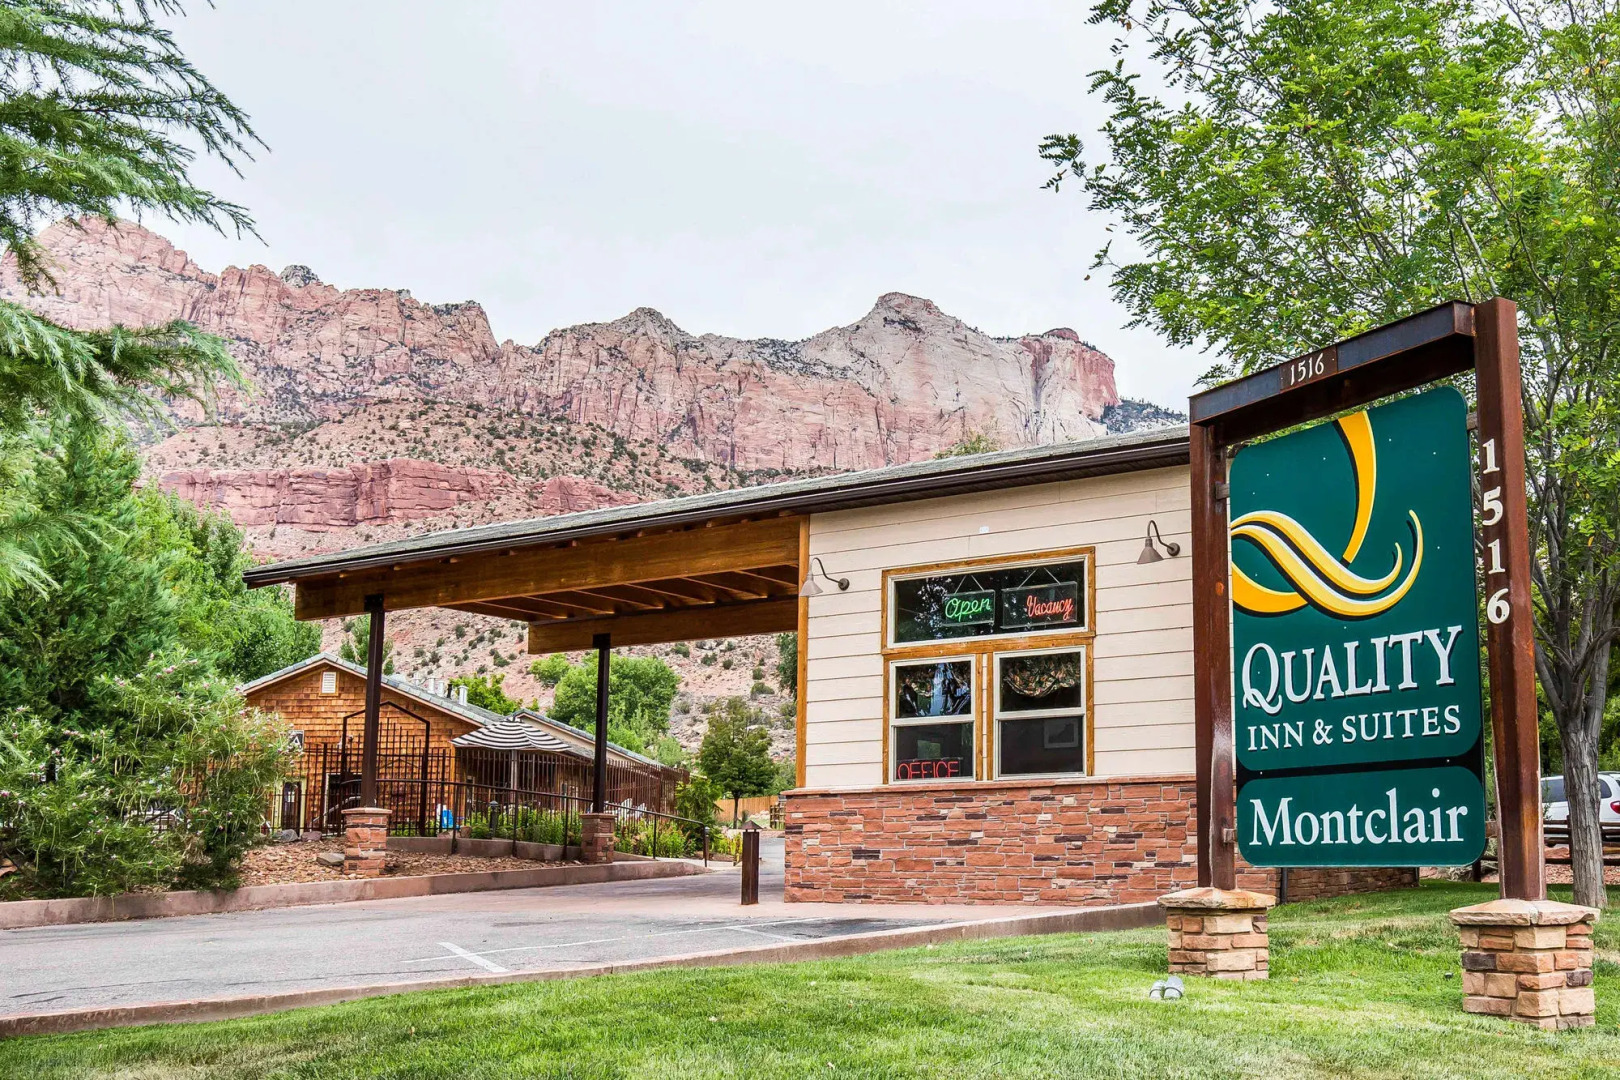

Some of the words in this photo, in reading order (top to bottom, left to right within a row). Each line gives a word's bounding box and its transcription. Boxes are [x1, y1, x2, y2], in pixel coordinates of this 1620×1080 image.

[1290, 353, 1325, 386] 1516
[1482, 438, 1511, 625] 1516
[945, 597, 991, 622] Open
[1026, 595, 1074, 621] Vacancy
[1241, 625, 1462, 714] QUALITY
[1247, 721, 1305, 751] INN
[1312, 718, 1334, 745] &
[1341, 704, 1461, 744] SUITES
[897, 760, 959, 780] OFFICE
[1249, 787, 1468, 846] Montclair
